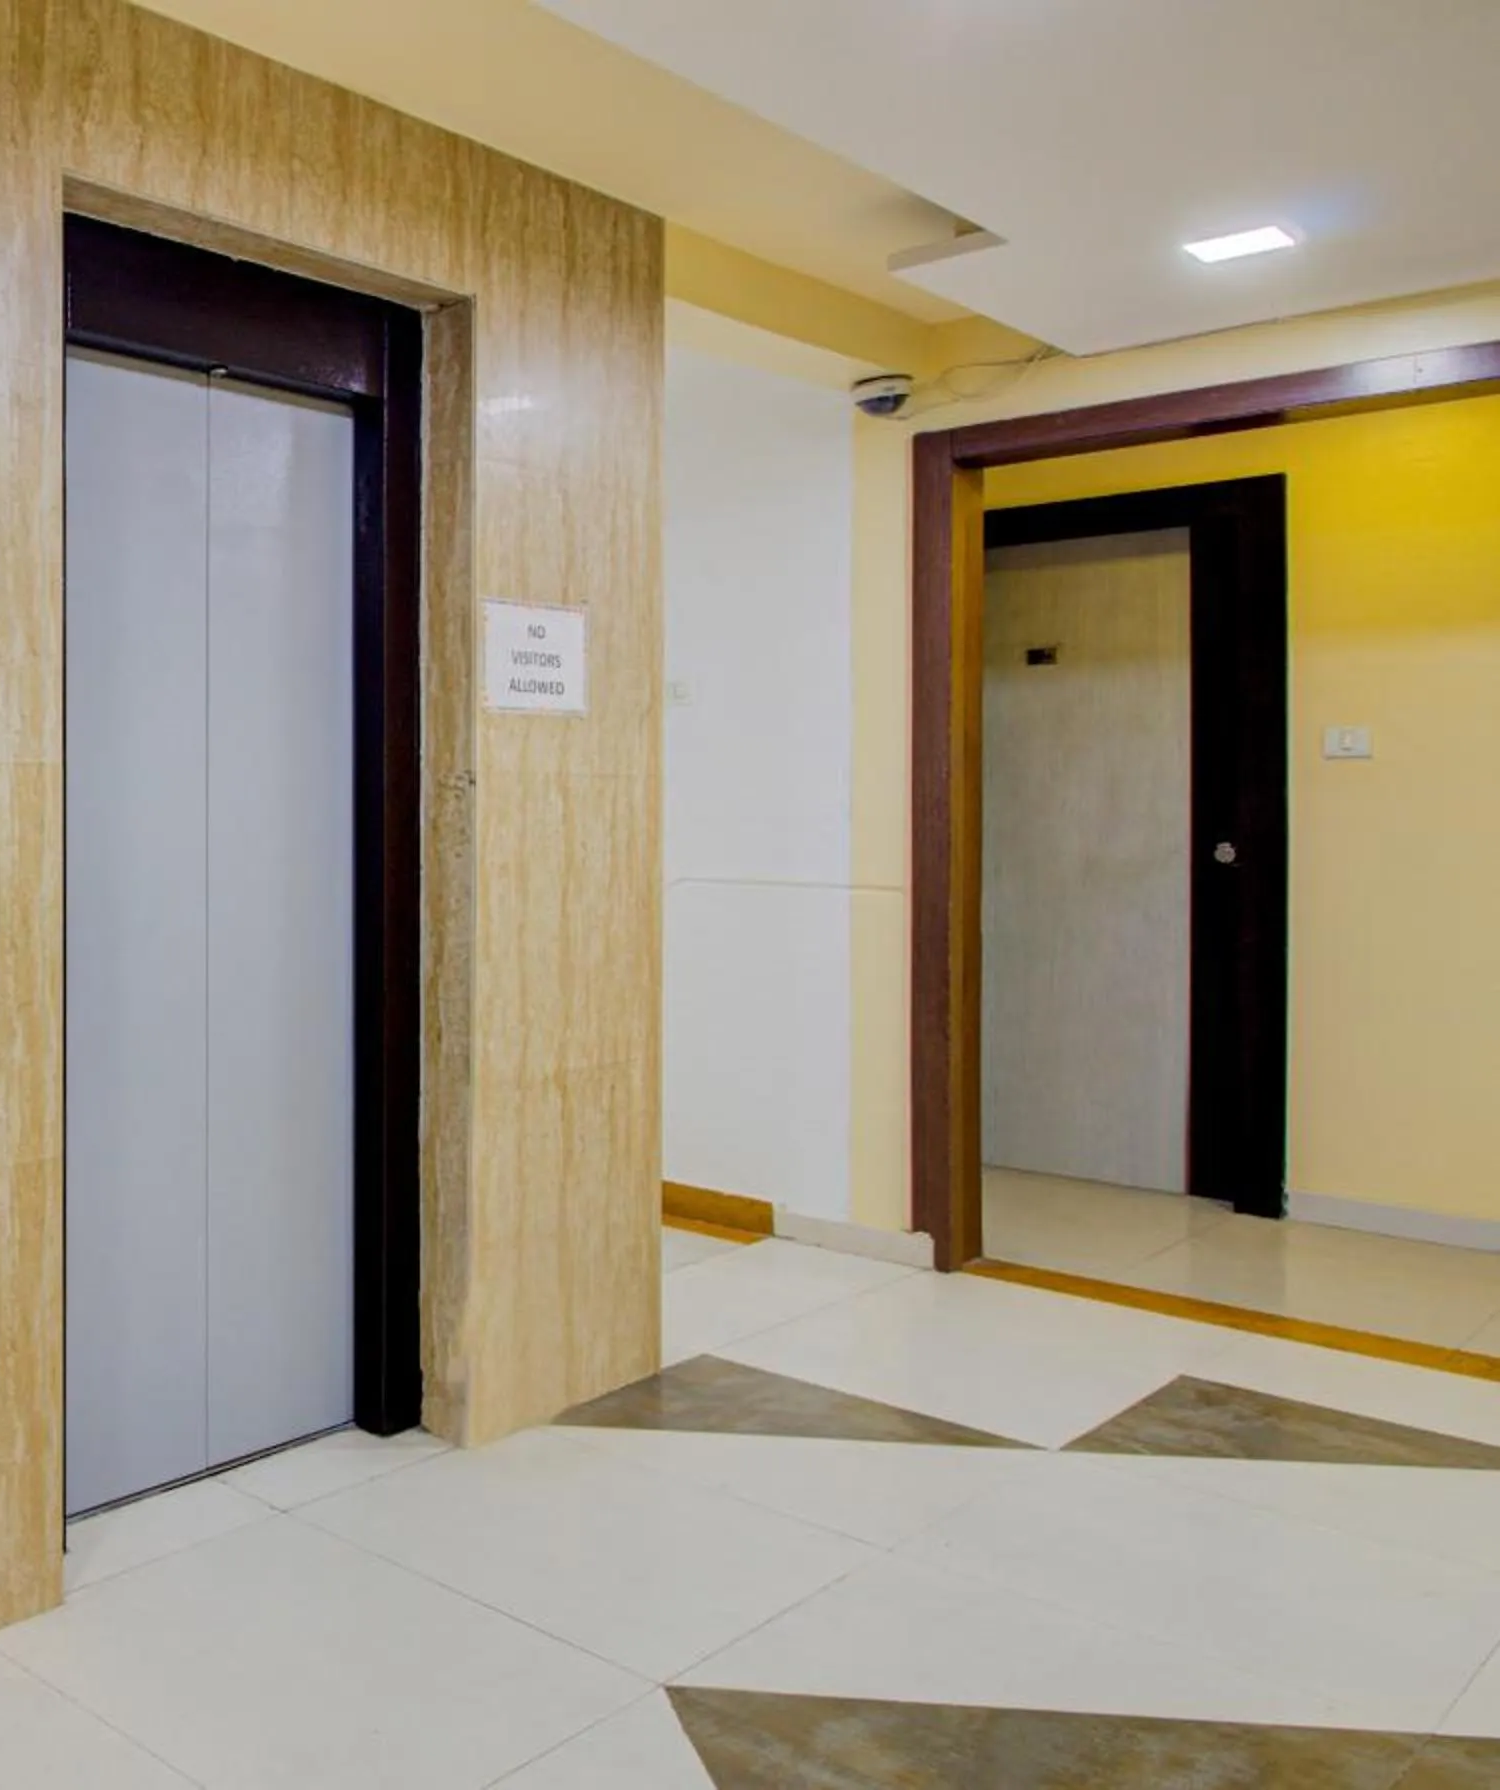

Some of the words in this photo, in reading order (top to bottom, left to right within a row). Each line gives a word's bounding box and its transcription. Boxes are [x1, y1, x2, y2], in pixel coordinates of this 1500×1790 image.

[527, 624, 546, 640] NO
[511, 648, 562, 669] VISITORS
[509, 677, 565, 696] ALLOWED
